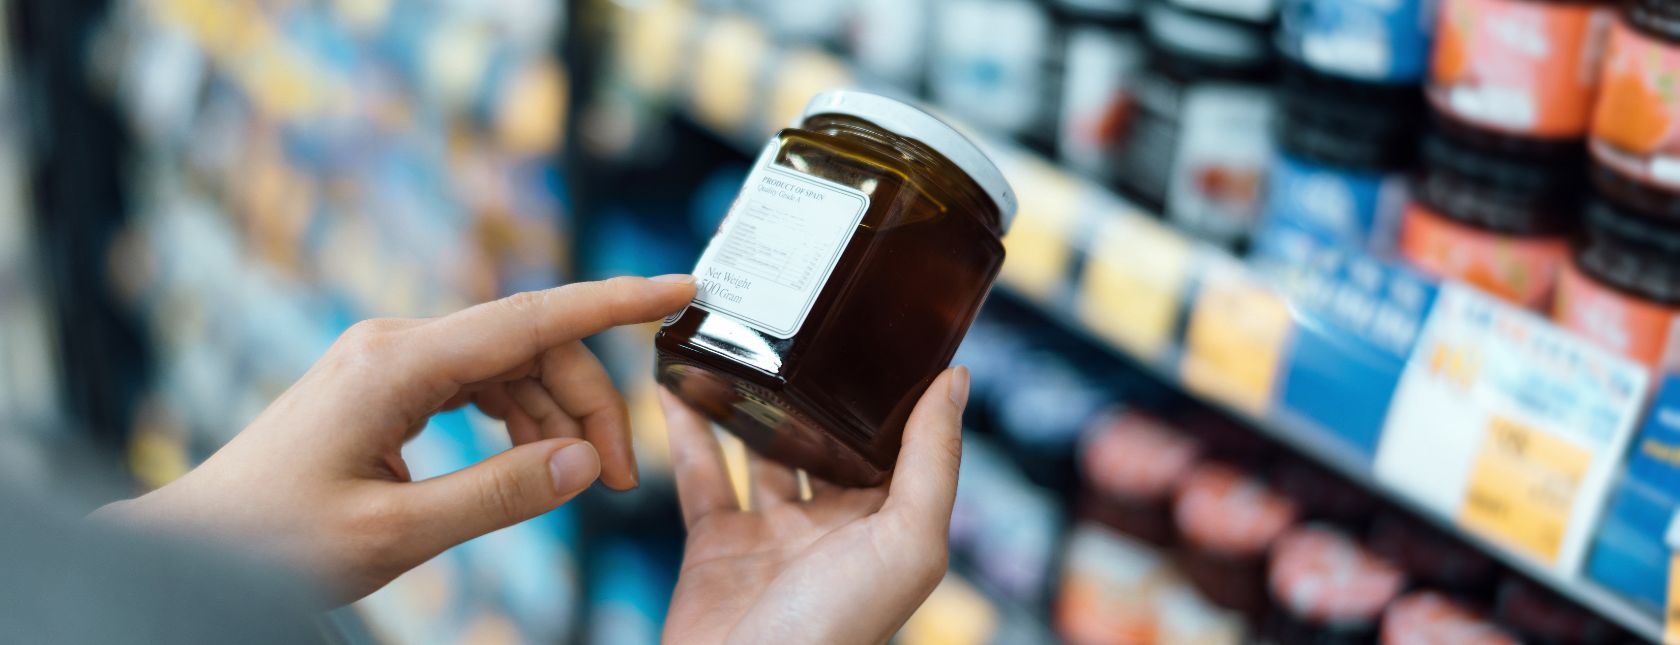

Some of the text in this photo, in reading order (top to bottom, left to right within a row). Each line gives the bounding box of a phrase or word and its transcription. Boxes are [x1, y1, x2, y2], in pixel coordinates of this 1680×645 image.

[757, 184, 777, 197] Quality
[762, 175, 795, 192] PRODUCT
[805, 190, 825, 201] SPAIN
[705, 266, 752, 290] Net Weight
[699, 278, 743, 304] 500 Gram
